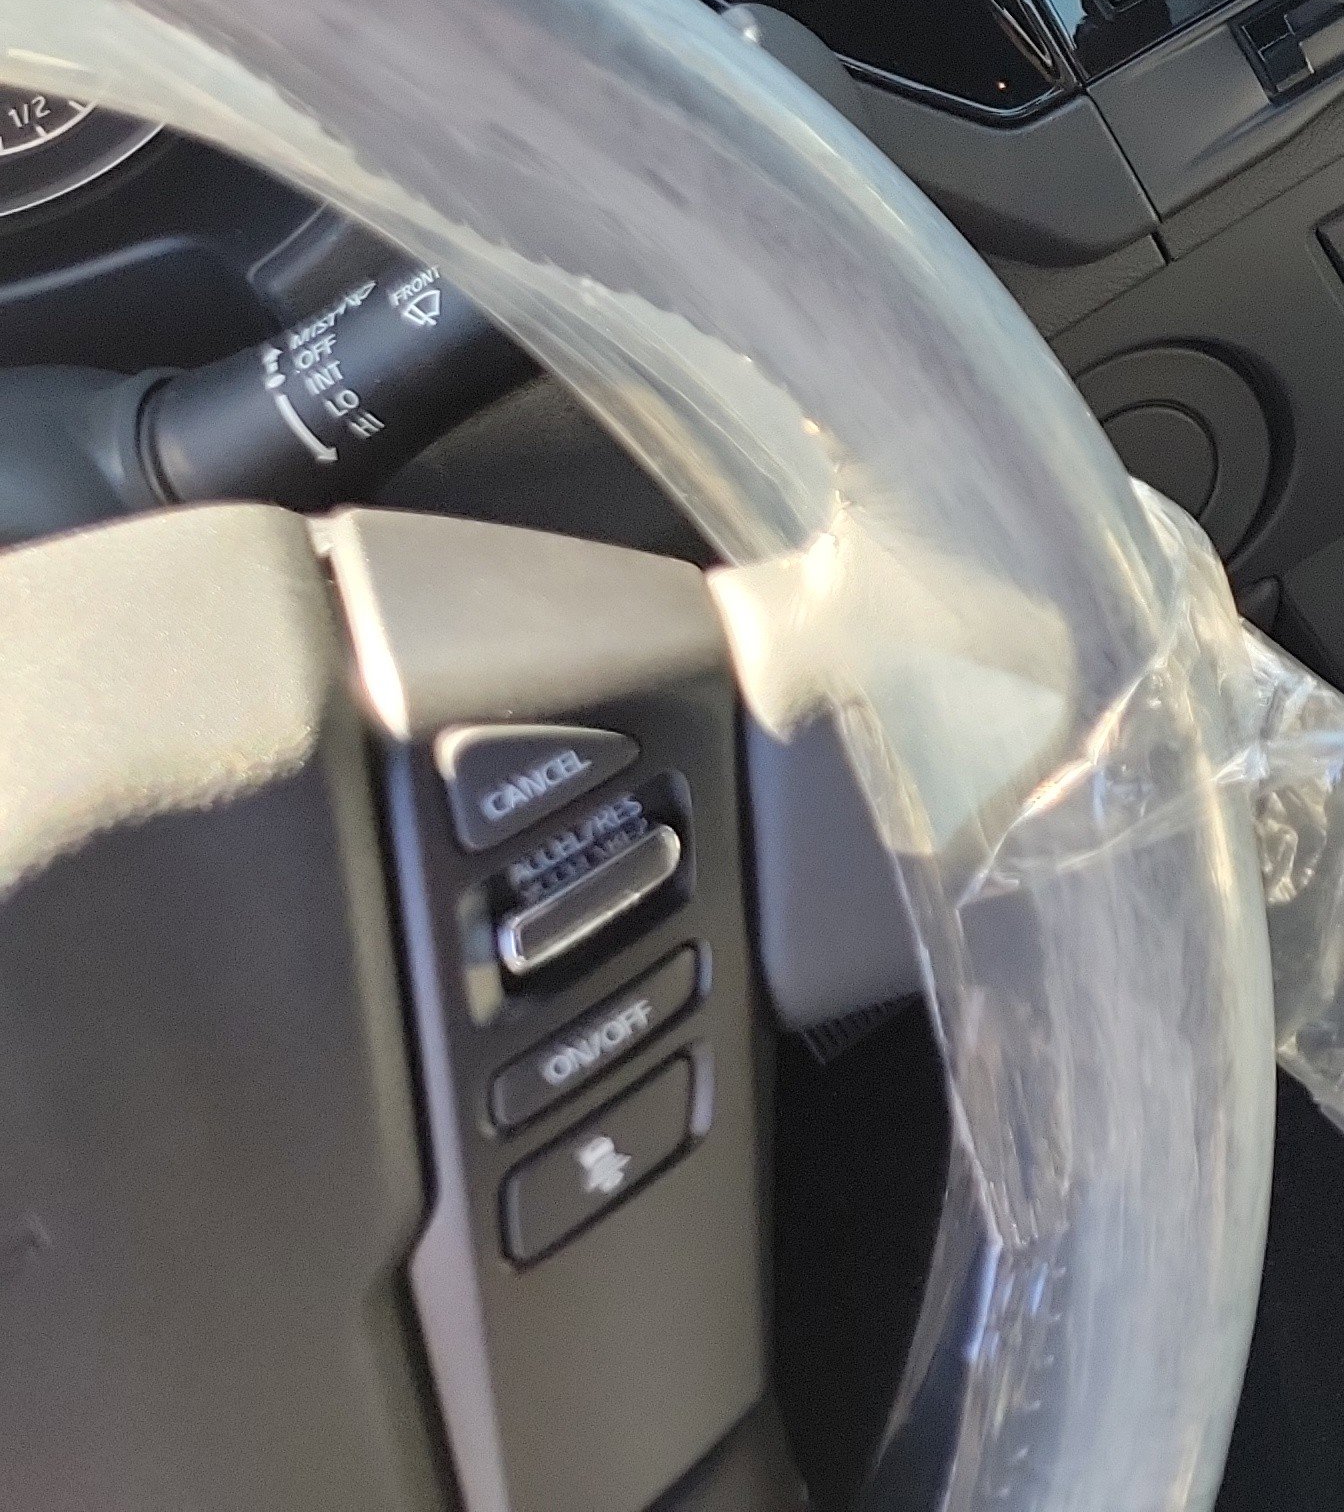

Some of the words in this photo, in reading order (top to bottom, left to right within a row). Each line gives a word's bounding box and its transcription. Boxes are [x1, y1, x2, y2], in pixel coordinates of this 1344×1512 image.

[8, 94, 53, 129] 1/2
[388, 266, 441, 307] FRONT
[288, 311, 337, 350] MIST
[294, 333, 337, 370] OFF
[305, 360, 344, 396] INT
[324, 389, 359, 418] LO
[350, 412, 386, 438] HI
[482, 750, 592, 821] CANCEL
[544, 998, 653, 1087] ON/OFF
